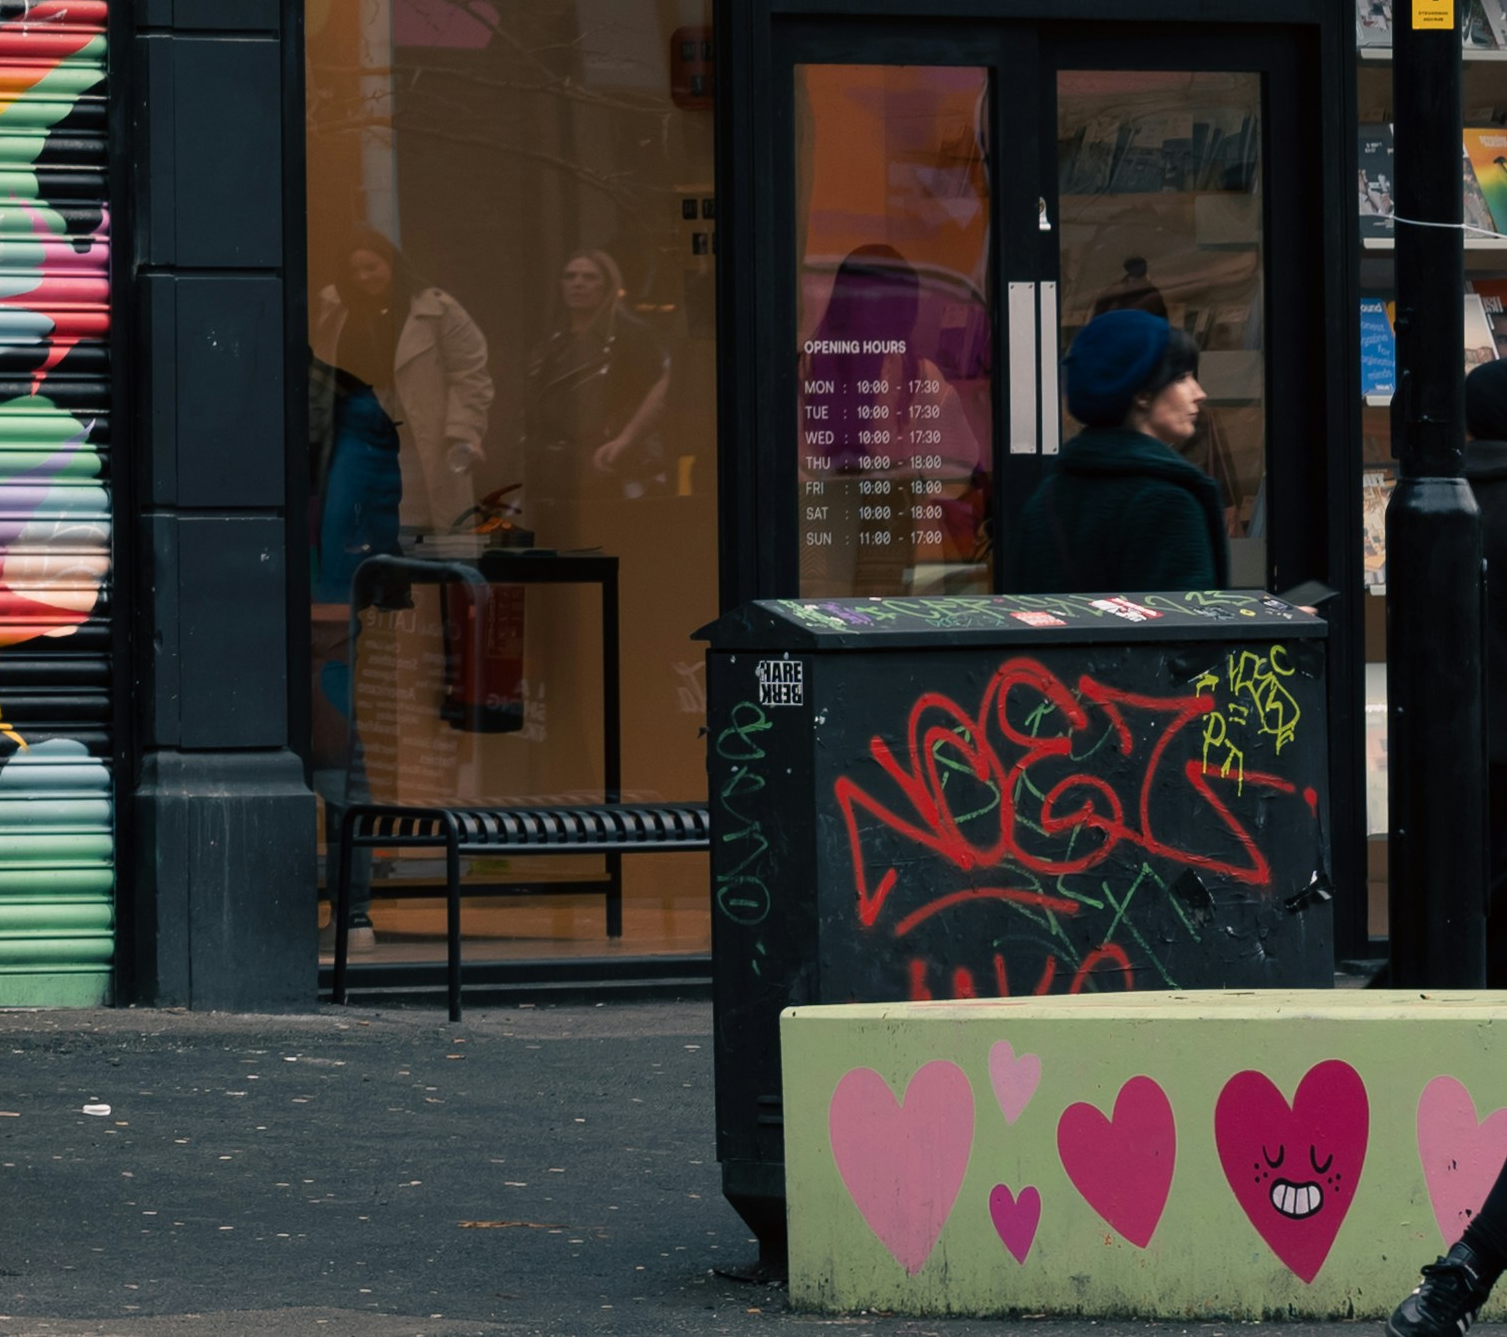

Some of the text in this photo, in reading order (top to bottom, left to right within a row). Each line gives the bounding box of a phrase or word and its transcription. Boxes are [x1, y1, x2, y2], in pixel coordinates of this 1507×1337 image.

[804, 340, 907, 355] OPENING HOURS
[804, 380, 940, 395] MON 10:00 17:30
[805, 405, 940, 420] TUE 10:00 17:30
[805, 430, 941, 445] WED 10:00 17:30
[806, 456, 941, 470] THU 10:00 18:00
[806, 481, 942, 496] FRI 10:00 18:00
[806, 506, 942, 520] SAT 10:00 18:00
[806, 531, 942, 546] SUN 11:00 17:00
